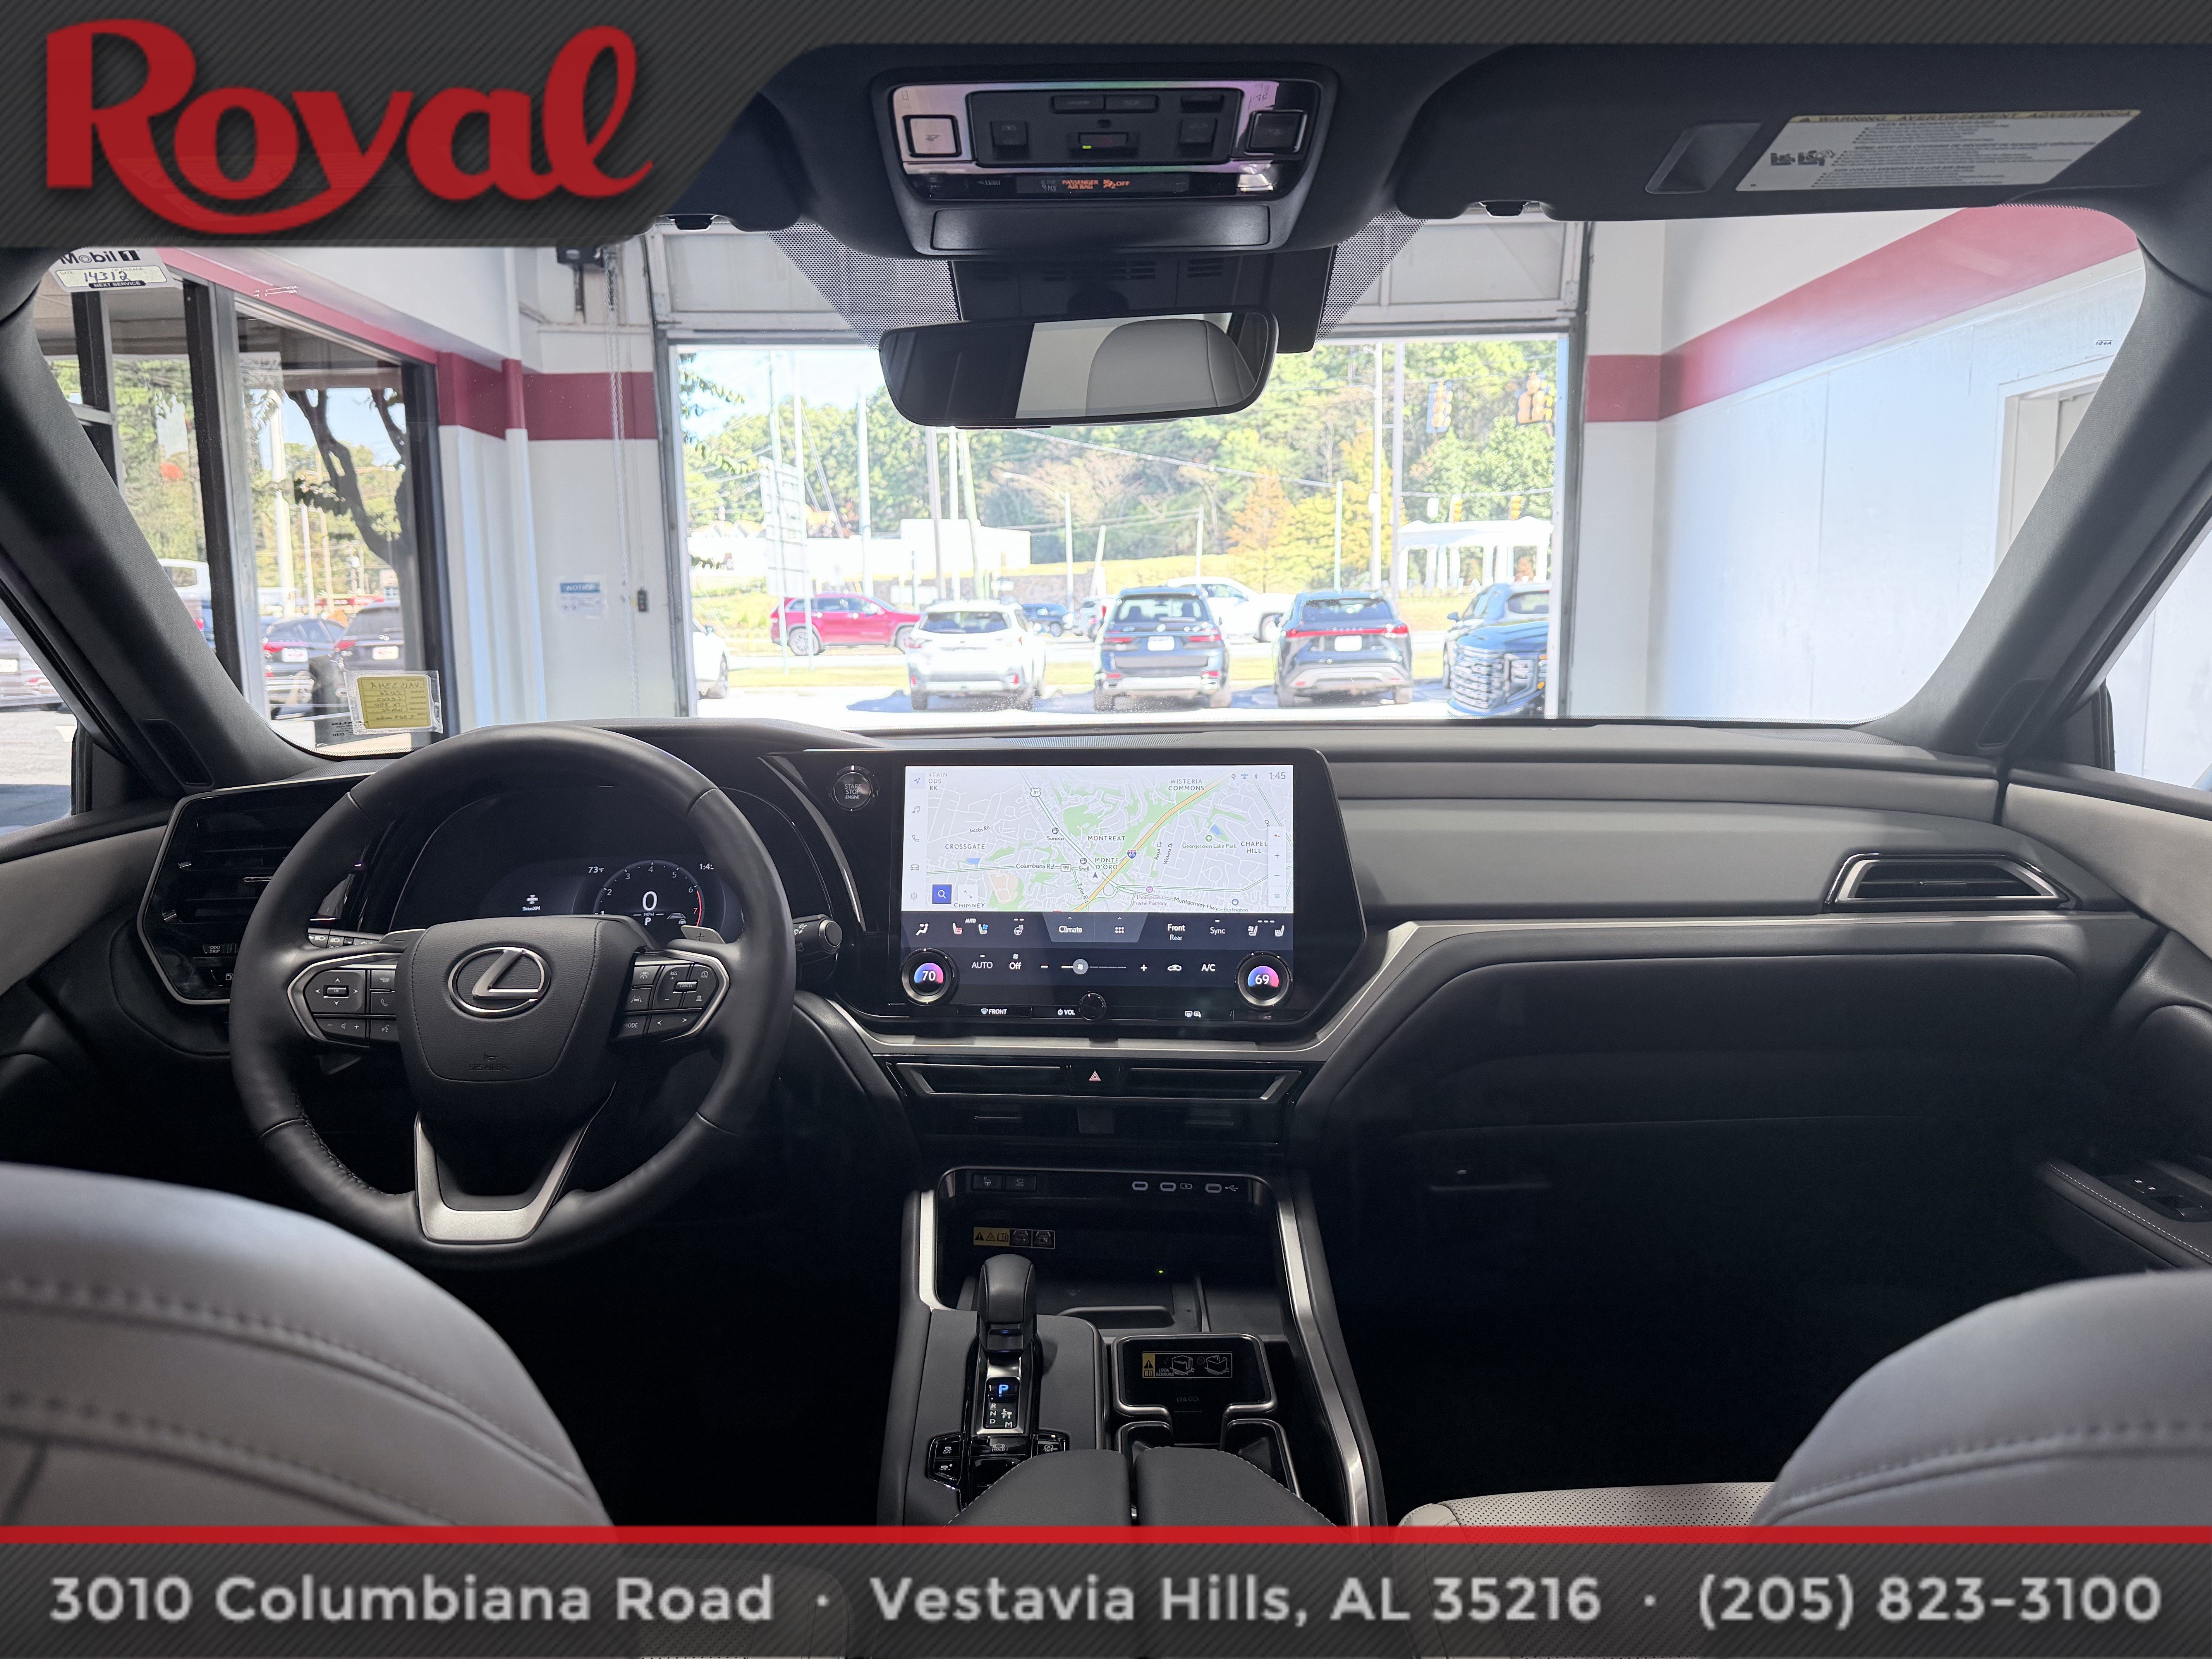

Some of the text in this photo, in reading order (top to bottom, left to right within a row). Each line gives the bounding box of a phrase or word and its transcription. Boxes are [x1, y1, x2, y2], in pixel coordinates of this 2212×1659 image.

[60, 251, 118, 264] Mobil
[84, 271, 131, 282] 14312
[642, 891, 658, 911] 0
[1173, 896, 1206, 908] Montgomery
[644, 917, 651, 926] P
[1058, 925, 1083, 933] Climate
[1167, 923, 1185, 932] Front
[1009, 962, 1022, 970] Off
[1201, 963, 1216, 972] A/C
[922, 970, 936, 982] 70
[1255, 974, 1270, 985] 69
[998, 1384, 1009, 1397] P
